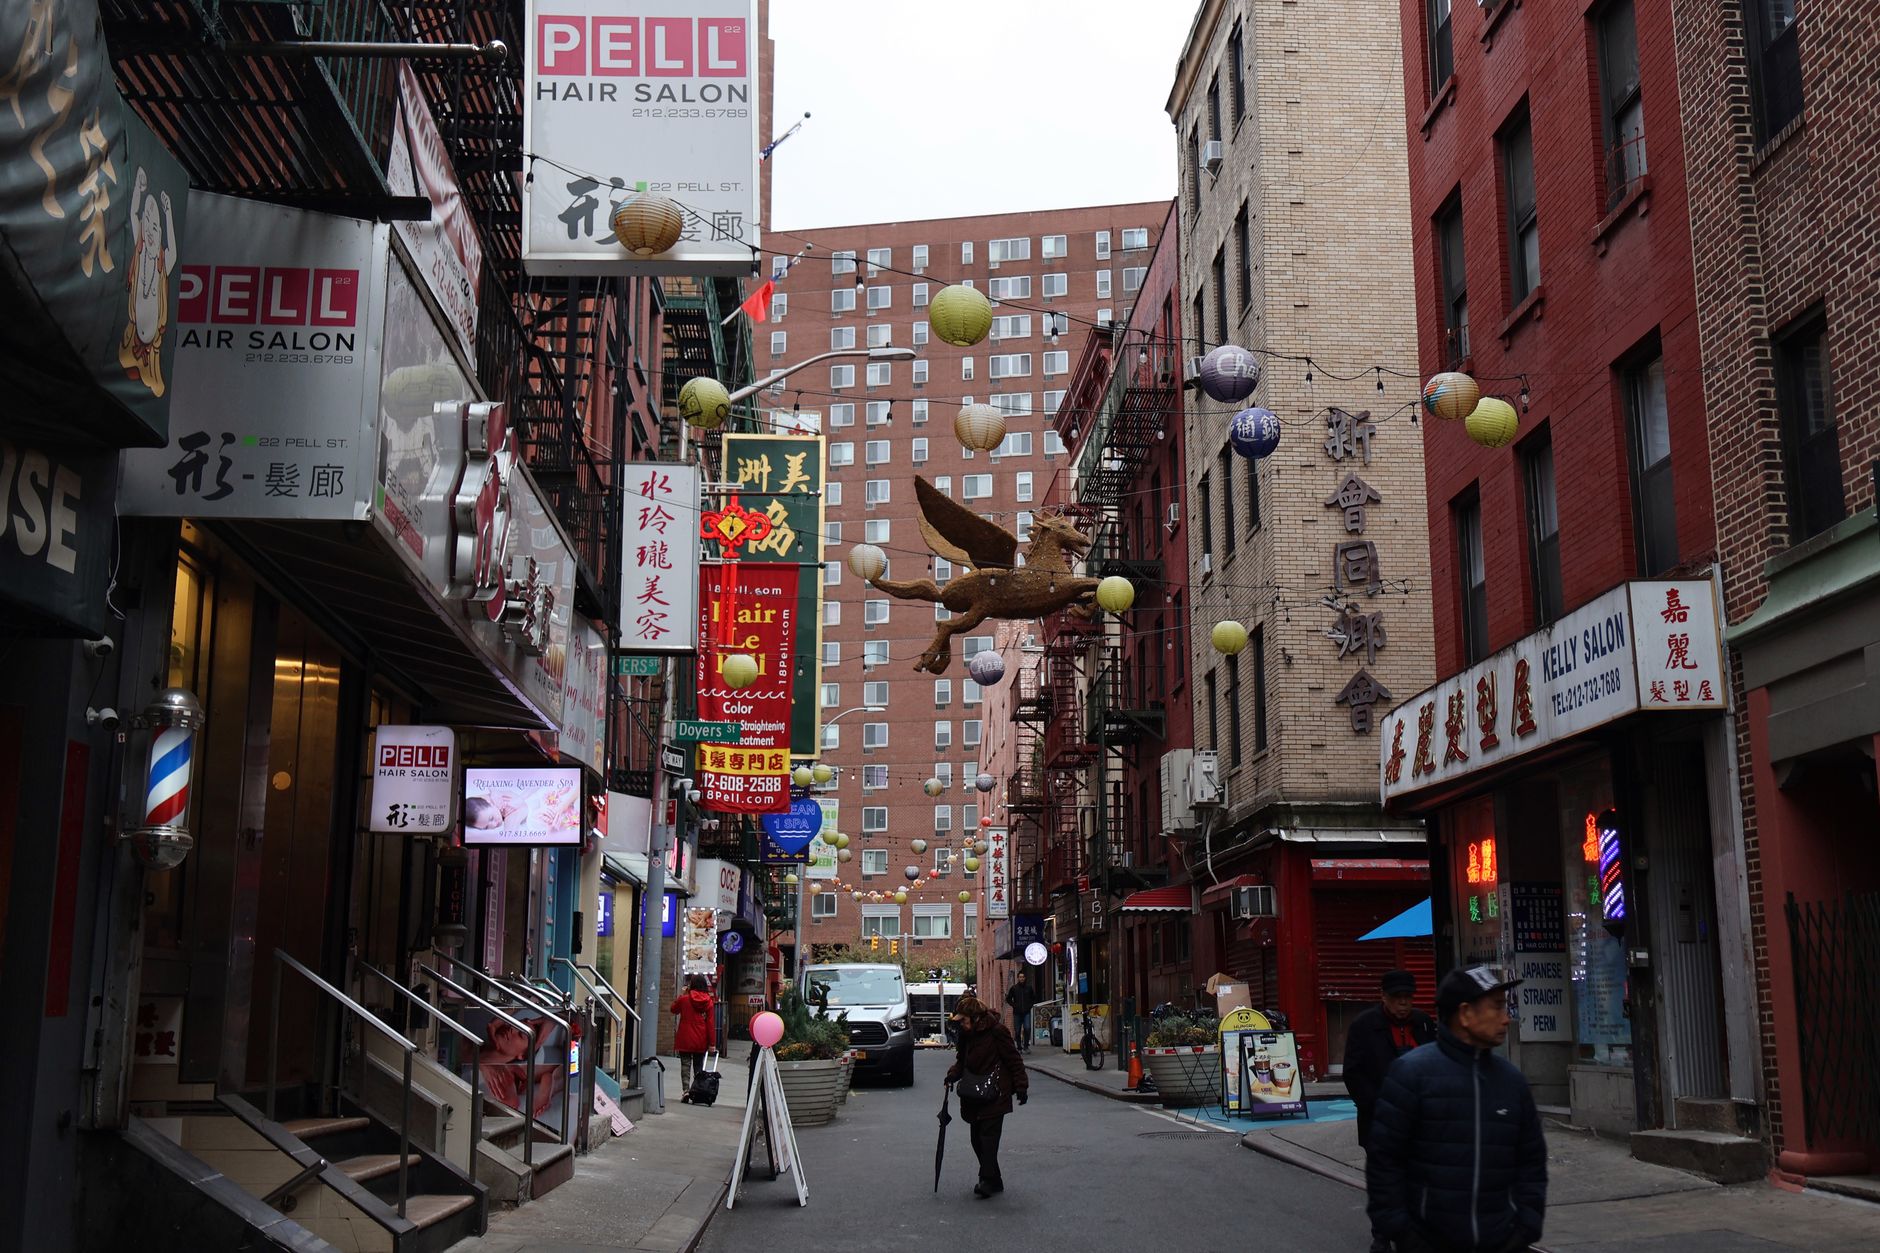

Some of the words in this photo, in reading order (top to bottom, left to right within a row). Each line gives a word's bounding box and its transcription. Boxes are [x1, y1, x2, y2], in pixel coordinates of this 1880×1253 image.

[543, 23, 738, 70] PELL
[723, 25, 742, 34] 22
[536, 81, 618, 102] HAIR
[634, 83, 748, 103] SALON
[632, 108, 748, 119] 212.233.6789
[650, 182, 672, 192] 22
[677, 182, 716, 193] PELL
[719, 182, 744, 193] ST.
[174, 329, 234, 350] AIR
[248, 330, 355, 352] SALON
[245, 352, 354, 365] 212.233.6789
[258, 437, 280, 448] 22
[285, 437, 322, 448] PELL
[326, 438, 349, 449] ST.
[635, 470, 675, 640] 水玲瓏美容
[1660, 588, 1698, 670] 嘉麗
[778, 608, 791, 685] 18Pell.com
[1542, 635, 1578, 683] KELLY
[1583, 611, 1626, 664] SALON
[1552, 666, 1622, 717] TEL:212-732-7688
[1649, 679, 1715, 703] 髮型屋
[722, 701, 754, 714] Color
[740, 719, 786, 735] Straightening
[1383, 657, 1538, 786] 嘉麗髮型屋
[679, 722, 723, 740] Doyers
[726, 724, 736, 734] St
[734, 735, 775, 747] eatment
[382, 746, 446, 765] PELL
[378, 769, 406, 777] HAIR
[410, 769, 448, 778] SALON
[788, 803, 816, 816] EAN
[783, 818, 811, 830] SPA
[498, 830, 547, 838] 917.813.6669
[1521, 962, 1562, 980] JAPANESE
[1523, 988, 1563, 1006] STRAIGHT
[1533, 1014, 1556, 1033] PERM
